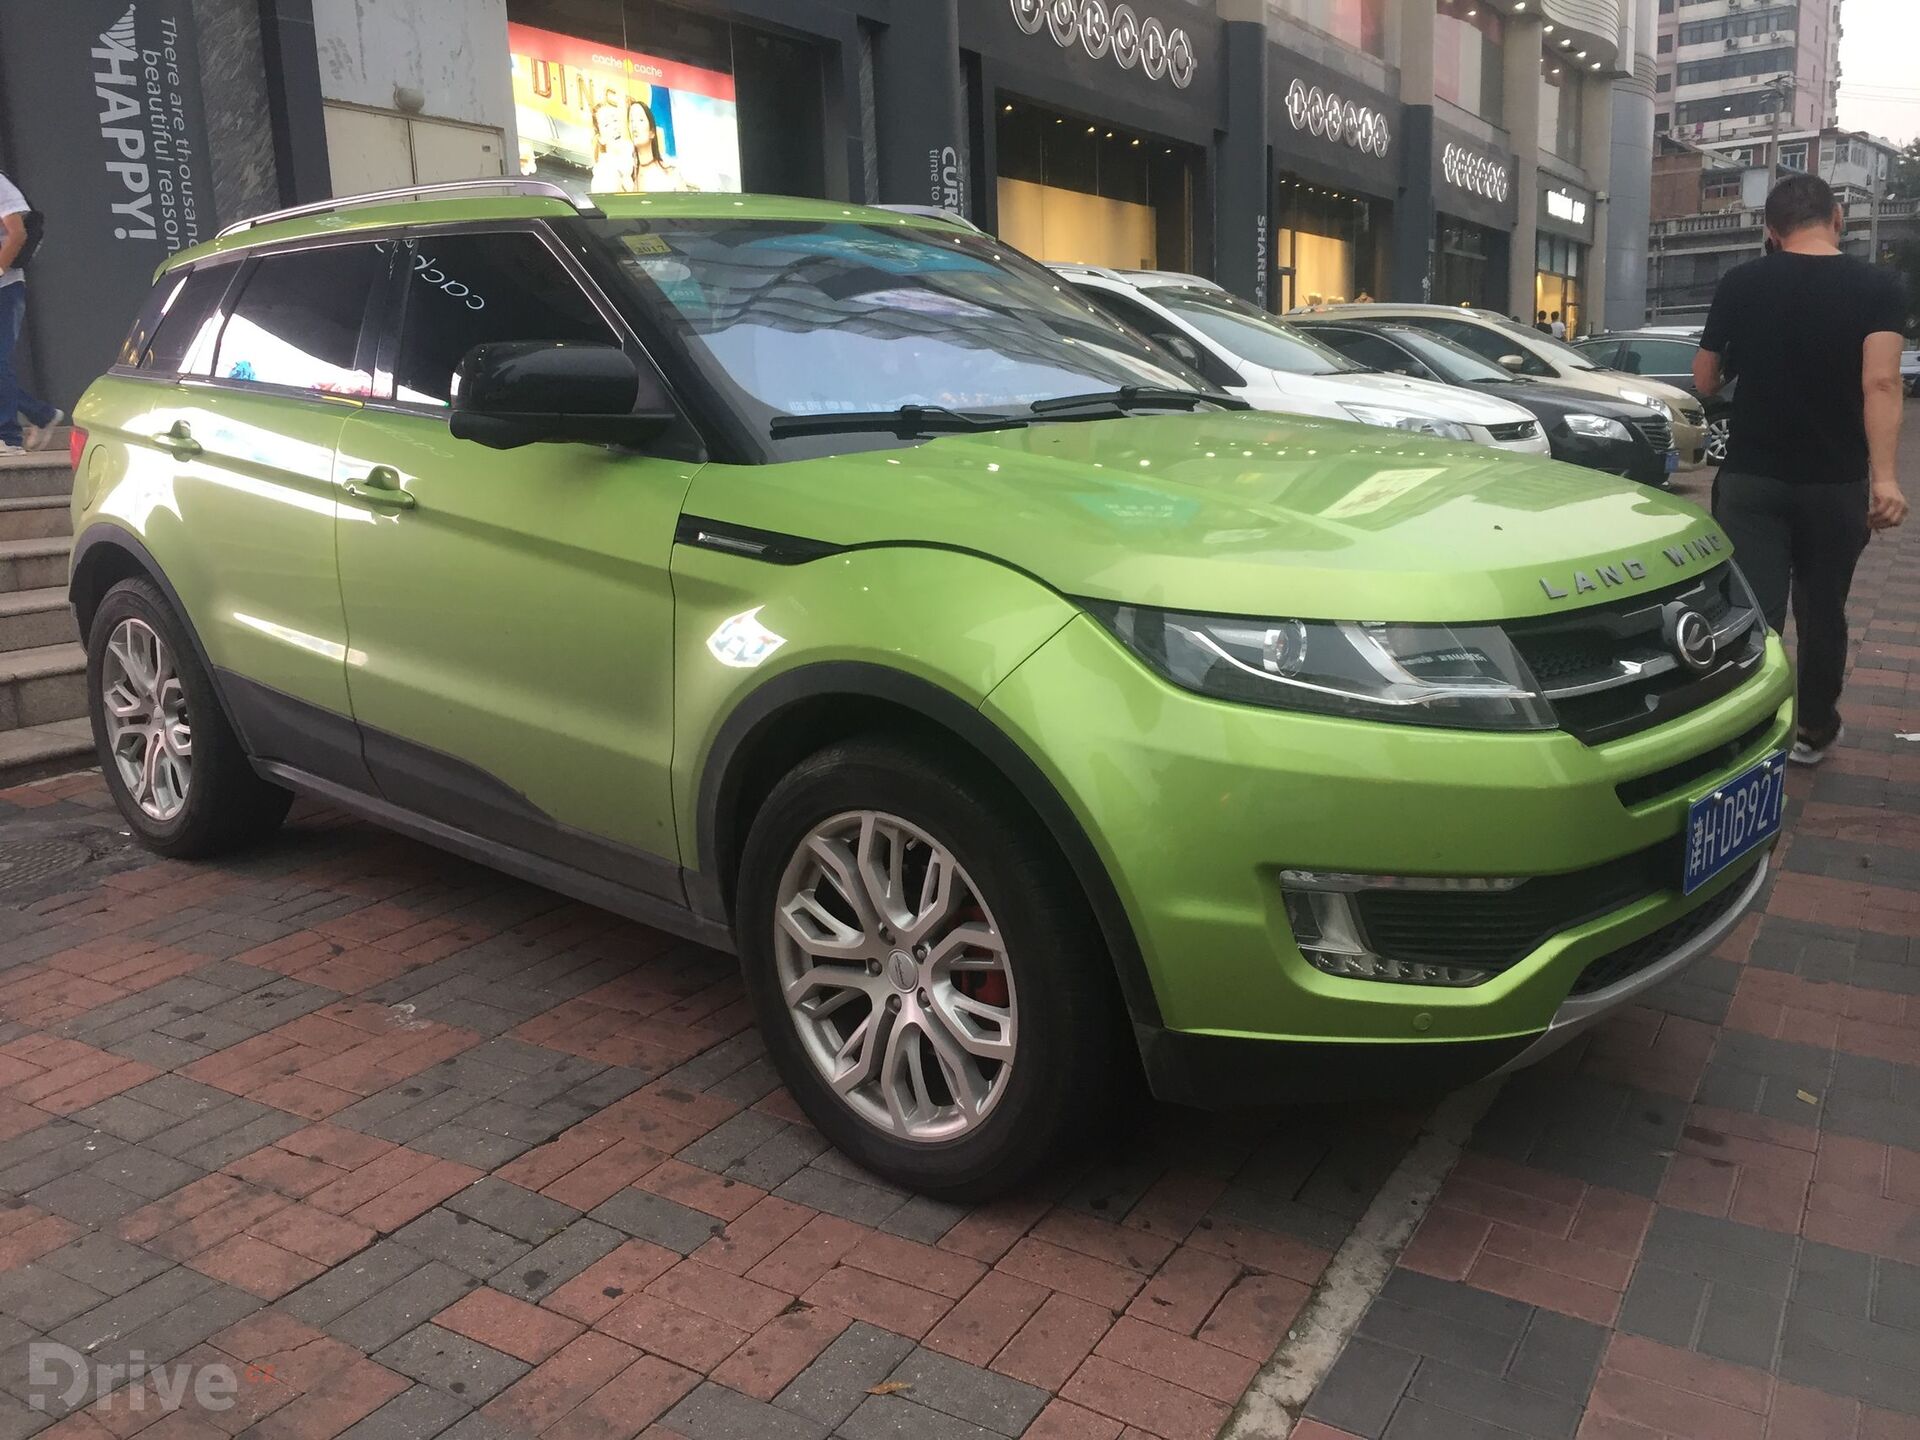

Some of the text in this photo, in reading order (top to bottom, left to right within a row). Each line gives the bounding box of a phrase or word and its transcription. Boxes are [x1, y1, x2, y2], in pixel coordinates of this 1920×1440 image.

[161, 16, 180, 86] There
[591, 54, 663, 78] cache cache
[170, 94, 185, 131] are
[91, 46, 158, 240] HAPPY!
[143, 49, 181, 258] beautiful reason
[929, 148, 940, 183] time
[931, 185, 941, 201] to
[1539, 532, 1722, 600] LAND WING
